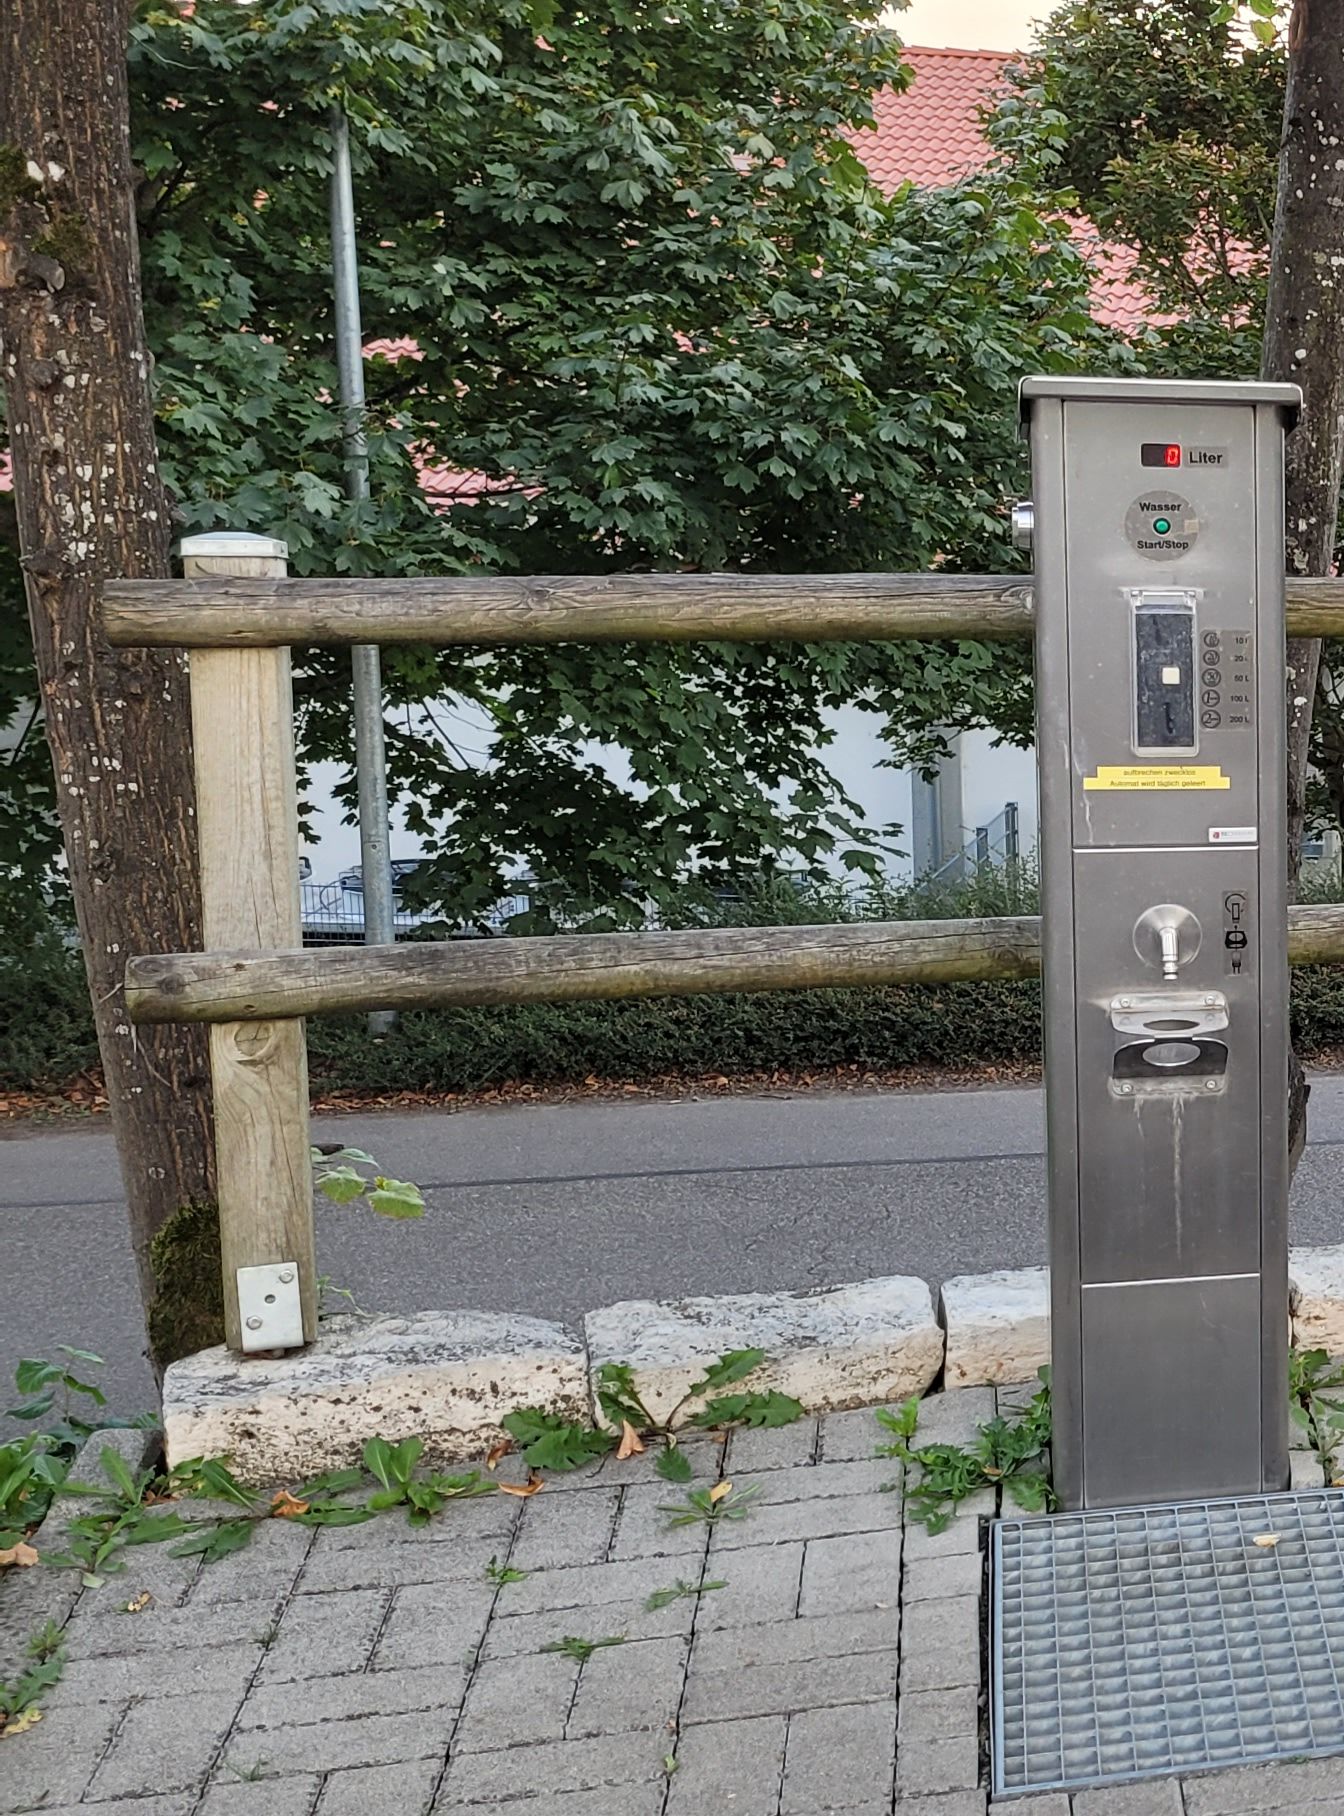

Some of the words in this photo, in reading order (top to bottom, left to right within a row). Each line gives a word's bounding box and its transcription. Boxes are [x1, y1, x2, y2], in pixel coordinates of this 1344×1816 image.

[1166, 447, 1179, 465] 0
[1189, 451, 1223, 464] Liter
[1139, 502, 1181, 512] Wasser
[1137, 540, 1189, 549] Start/Stop
